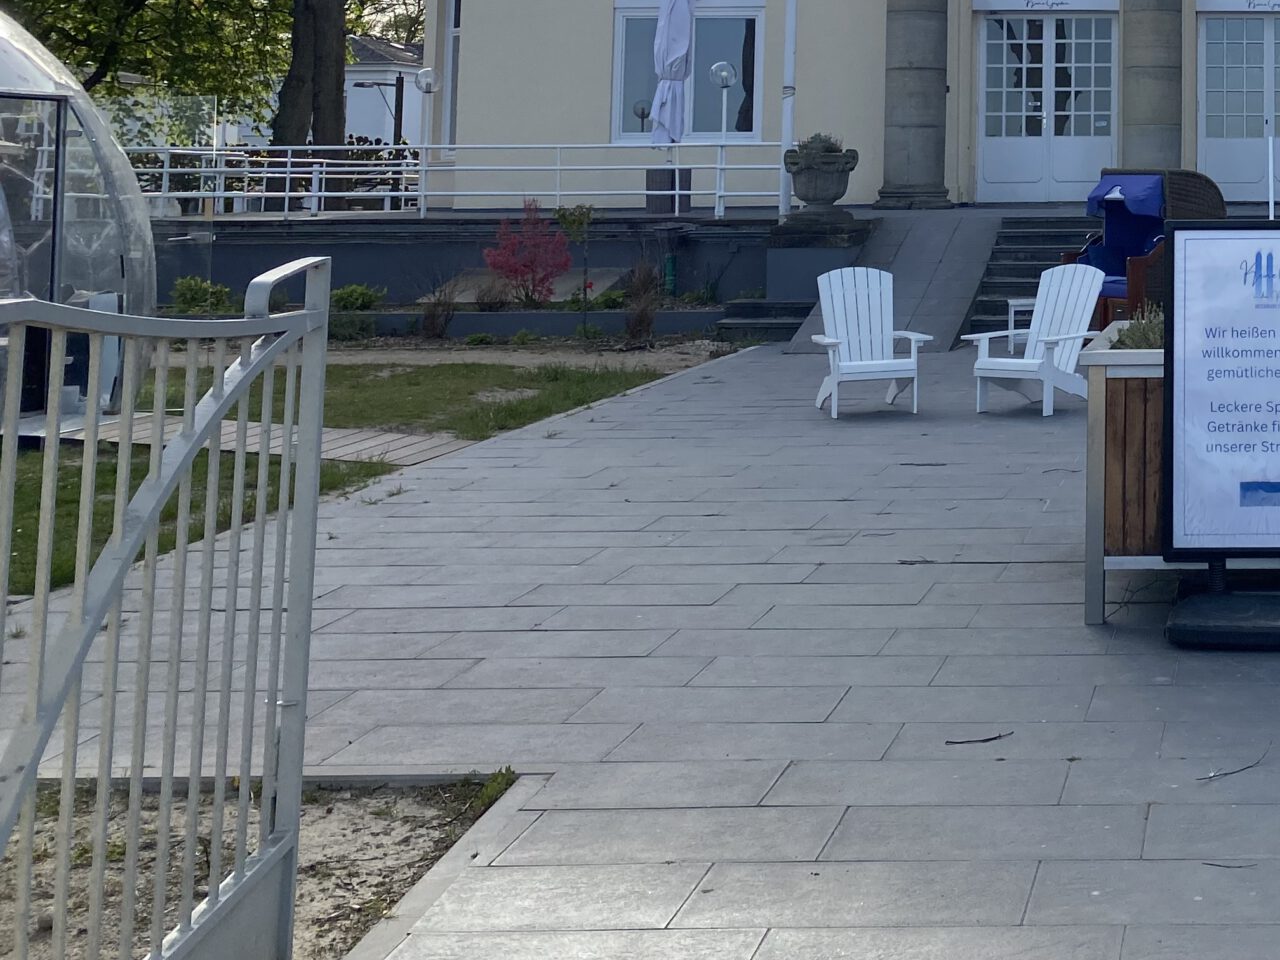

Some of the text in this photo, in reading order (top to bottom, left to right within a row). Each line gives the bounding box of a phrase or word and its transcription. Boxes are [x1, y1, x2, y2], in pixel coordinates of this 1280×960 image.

[1204, 326, 1228, 339] Wir
[1230, 326, 1276, 339] heißen
[1210, 400, 1262, 413] Leckere
[1207, 420, 1268, 433] Getränke
[1206, 441, 1258, 453] unserer
